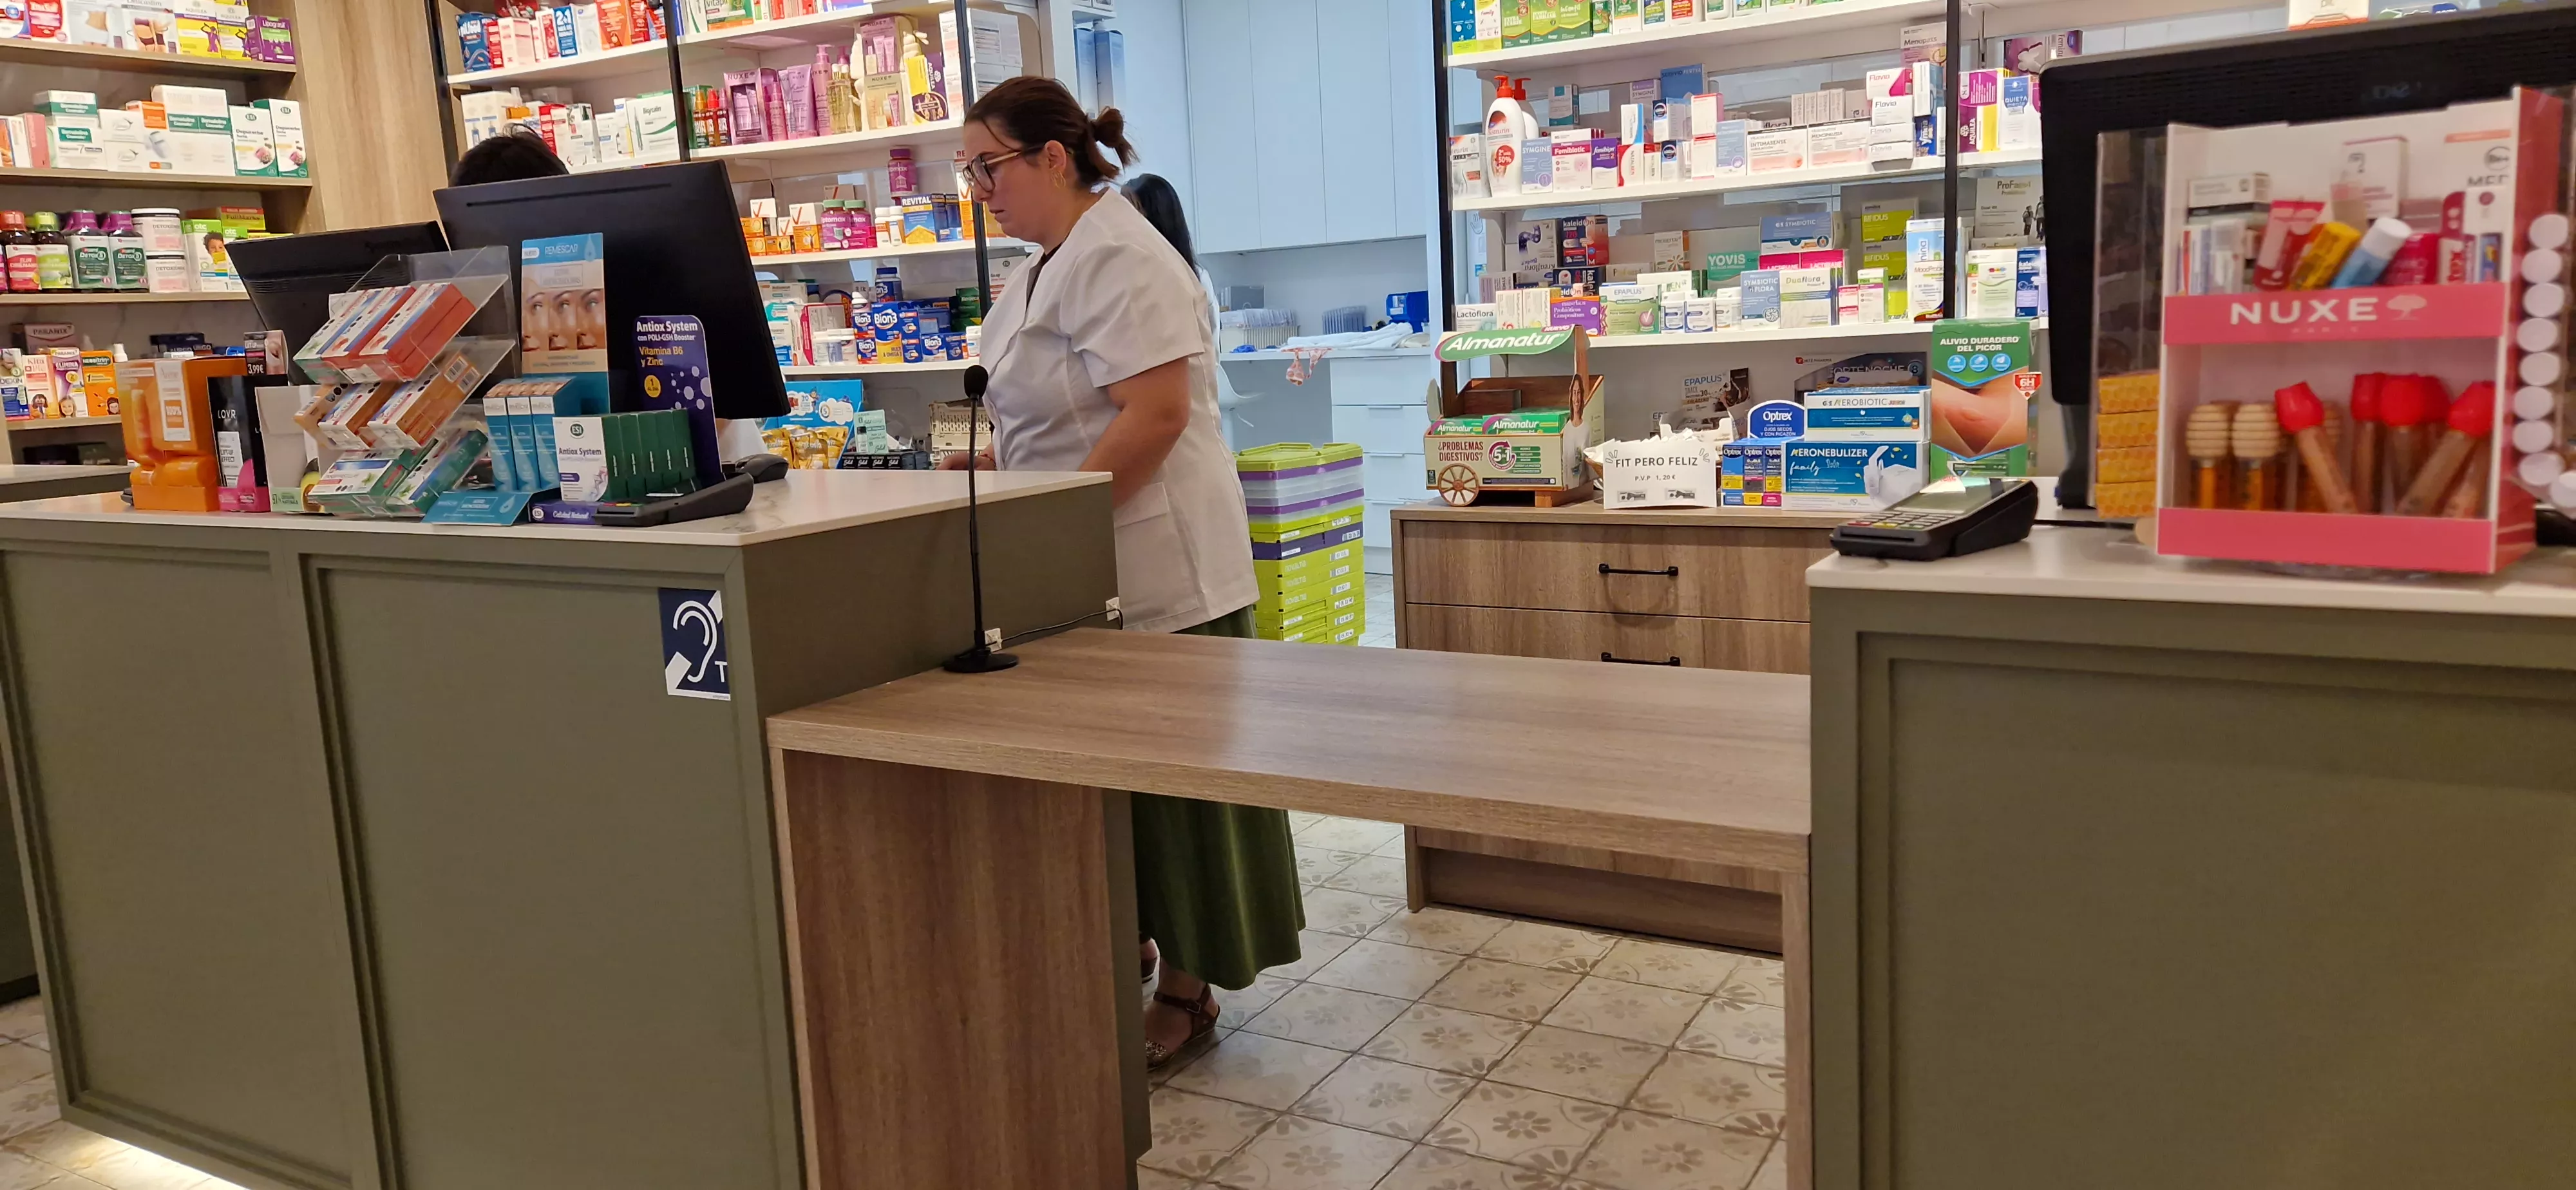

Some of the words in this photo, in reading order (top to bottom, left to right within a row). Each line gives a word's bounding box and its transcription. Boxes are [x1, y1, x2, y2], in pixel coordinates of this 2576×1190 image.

[1904, 36, 1937, 46] Menopass
[1750, 139, 1787, 147] INTIMASENSE
[1554, 146, 1586, 155] Femibiotic
[902, 195, 931, 206] REVITAL
[1863, 214, 1889, 223] BIFIDUS
[545, 243, 578, 255] REMESCAR
[1708, 254, 1746, 266] YOVIS
[1864, 253, 1889, 261] BIFIDUS
[1744, 278, 1778, 287] SYMBIOTIC
[1614, 288, 1642, 296] EPAPLUS
[1457, 310, 1493, 318] Lactoflora
[2230, 298, 2379, 326] NUXE
[855, 314, 871, 323] Bion3
[875, 313, 897, 324] Bion3
[636, 321, 665, 331] Antiox
[666, 321, 698, 334] System
[925, 337, 942, 347] Bion3
[1446, 332, 1560, 352] Almanatur
[1970, 336, 2020, 345] DURADERO
[639, 346, 671, 355] Vitamina
[673, 346, 683, 355] B6
[859, 341, 875, 351] Bion3
[641, 359, 646, 367] y
[647, 357, 663, 366] Zinc
[1911, 364, 1918, 374] 8
[1684, 375, 1722, 386] EPAPLUS
[2020, 378, 2035, 386] 6H
[1833, 397, 1888, 406] AEROBIOTIC
[1763, 411, 1793, 423] Optrex
[1437, 424, 1473, 433] Almanatur
[1493, 420, 1539, 430] Almanatur
[572, 426, 582, 435] ESI
[1438, 441, 1484, 451] ¿PROBLEMAS
[579, 448, 601, 457] System
[1439, 452, 1484, 462] DIGESTIVOS?
[1723, 448, 1742, 457] Optrex
[1744, 448, 1763, 457] Optrex
[1765, 448, 1782, 457] Optre
[1790, 448, 1868, 457] AERONEBULIZER
[1615, 458, 1631, 468] FIT
[1634, 457, 1665, 467] PERO
[1669, 457, 1698, 466] FELIZ
[1790, 460, 1821, 476] family
[714, 661, 728, 683] T
